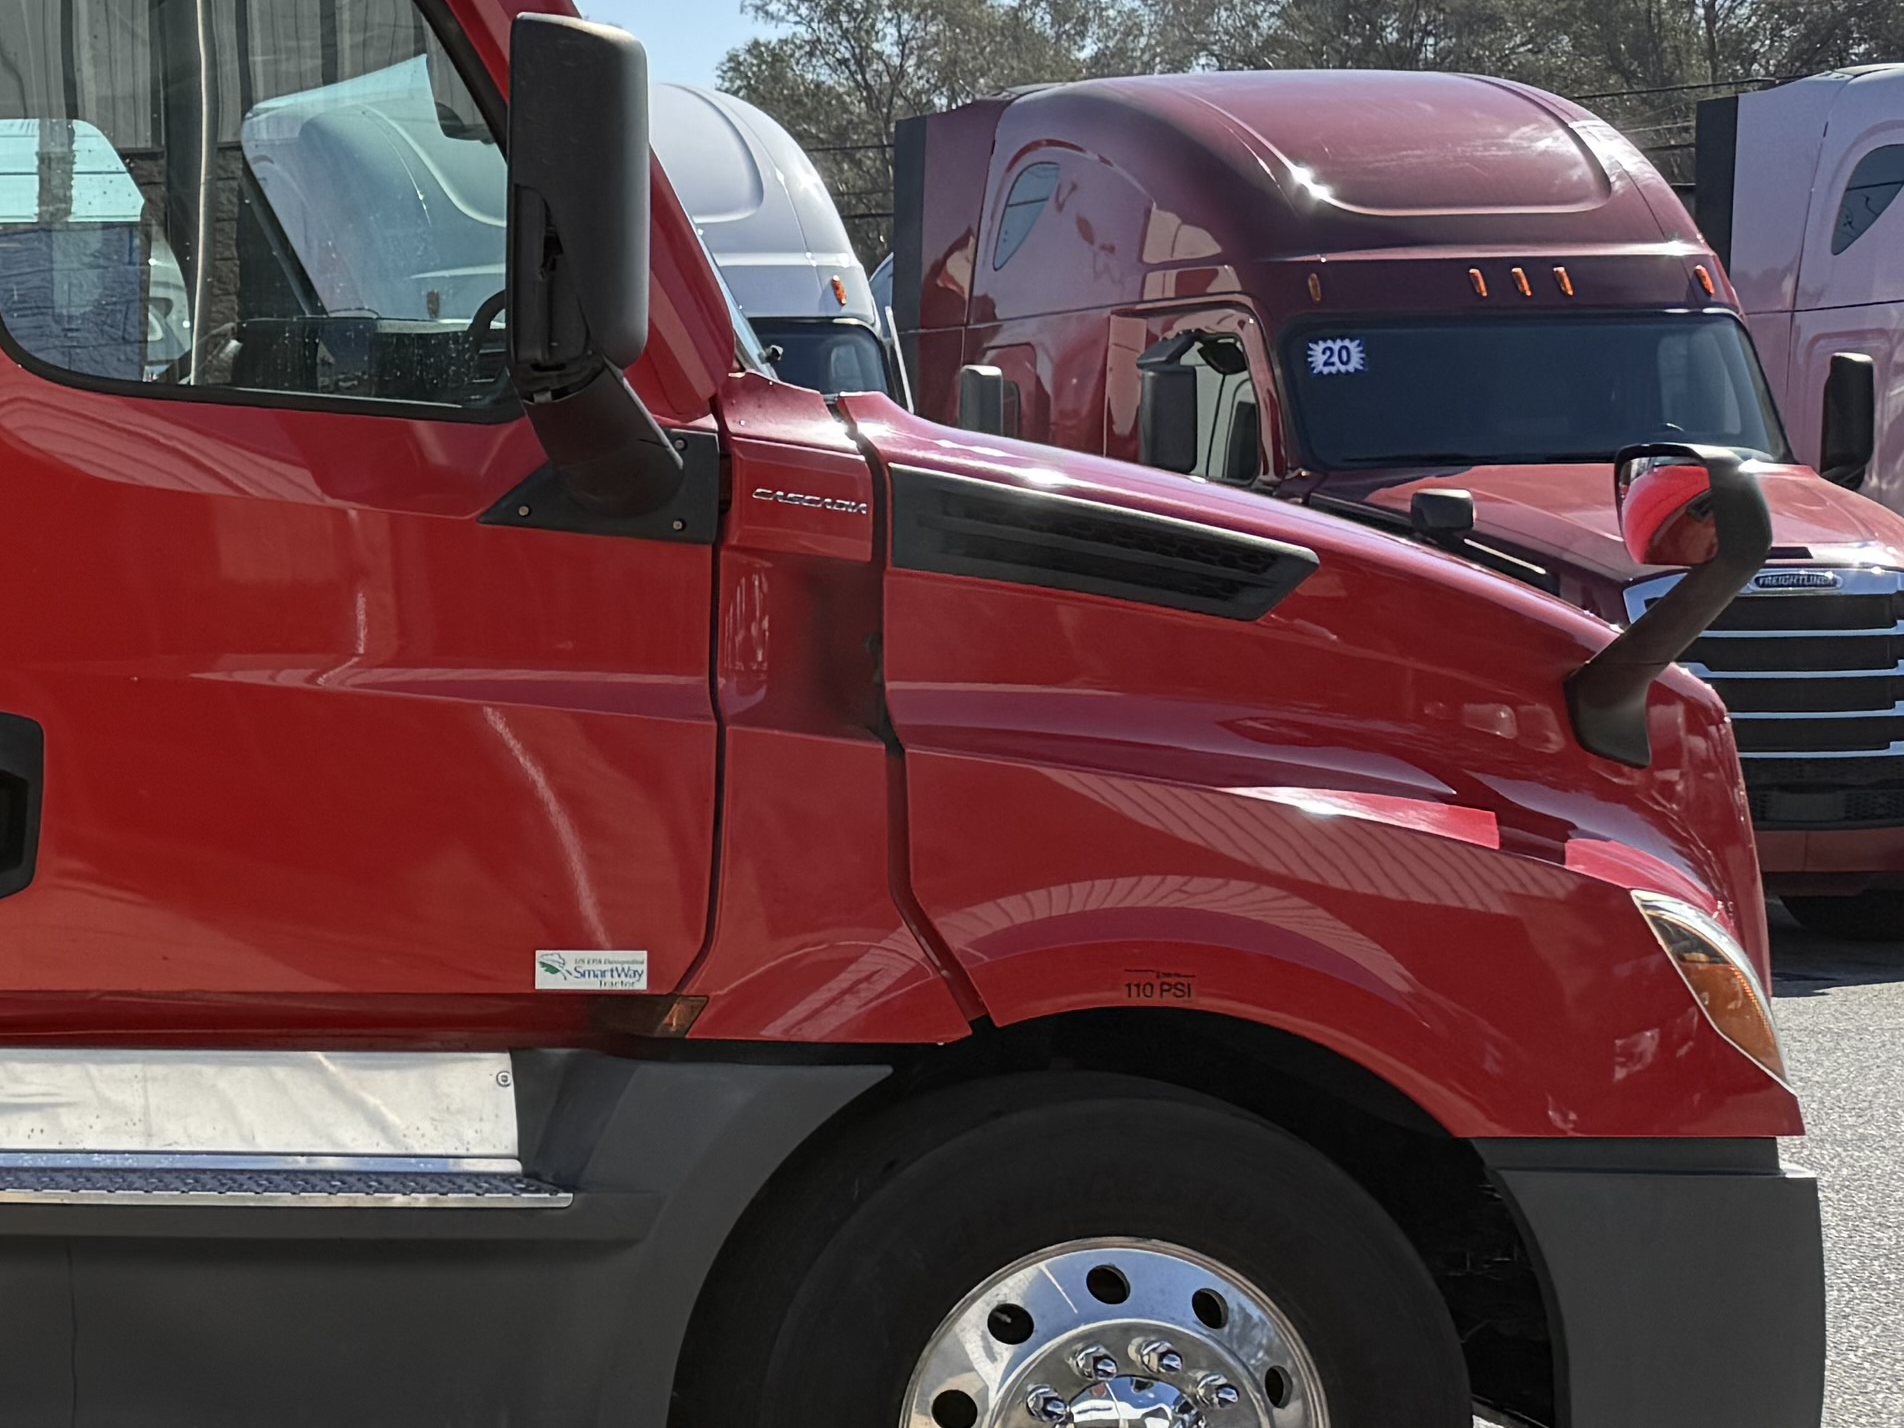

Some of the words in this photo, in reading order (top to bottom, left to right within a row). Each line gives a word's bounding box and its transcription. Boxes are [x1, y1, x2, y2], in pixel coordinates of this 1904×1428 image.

[1322, 345, 1351, 367] 20
[752, 488, 868, 514] CASCADIA
[574, 966, 644, 982] SmartWay
[1125, 982, 1154, 998] 110
[1159, 982, 1191, 998] PSI
